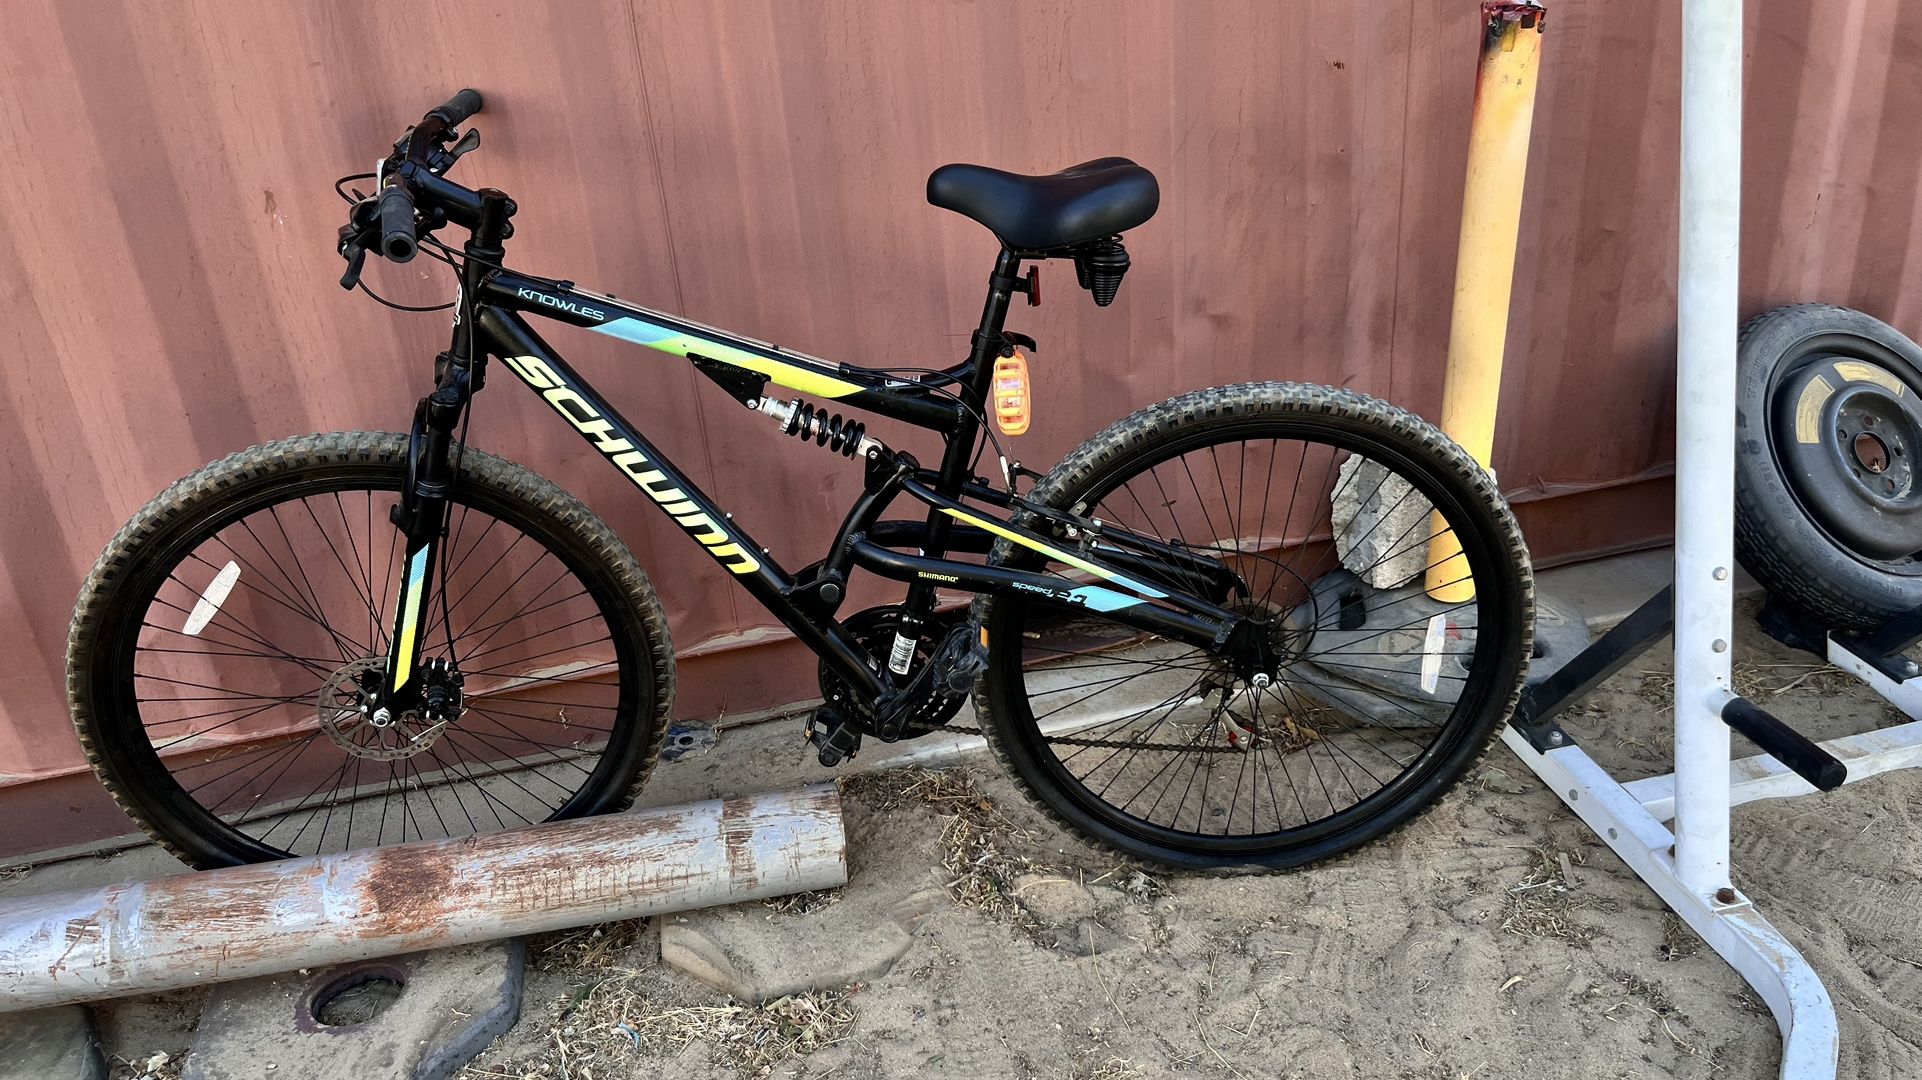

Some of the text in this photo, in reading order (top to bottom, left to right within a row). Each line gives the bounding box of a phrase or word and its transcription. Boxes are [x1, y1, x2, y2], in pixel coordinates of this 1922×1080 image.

[518, 287, 605, 321] KNOWLES
[504, 355, 761, 574] SCHWINN
[918, 571, 957, 583] SHIMANO
